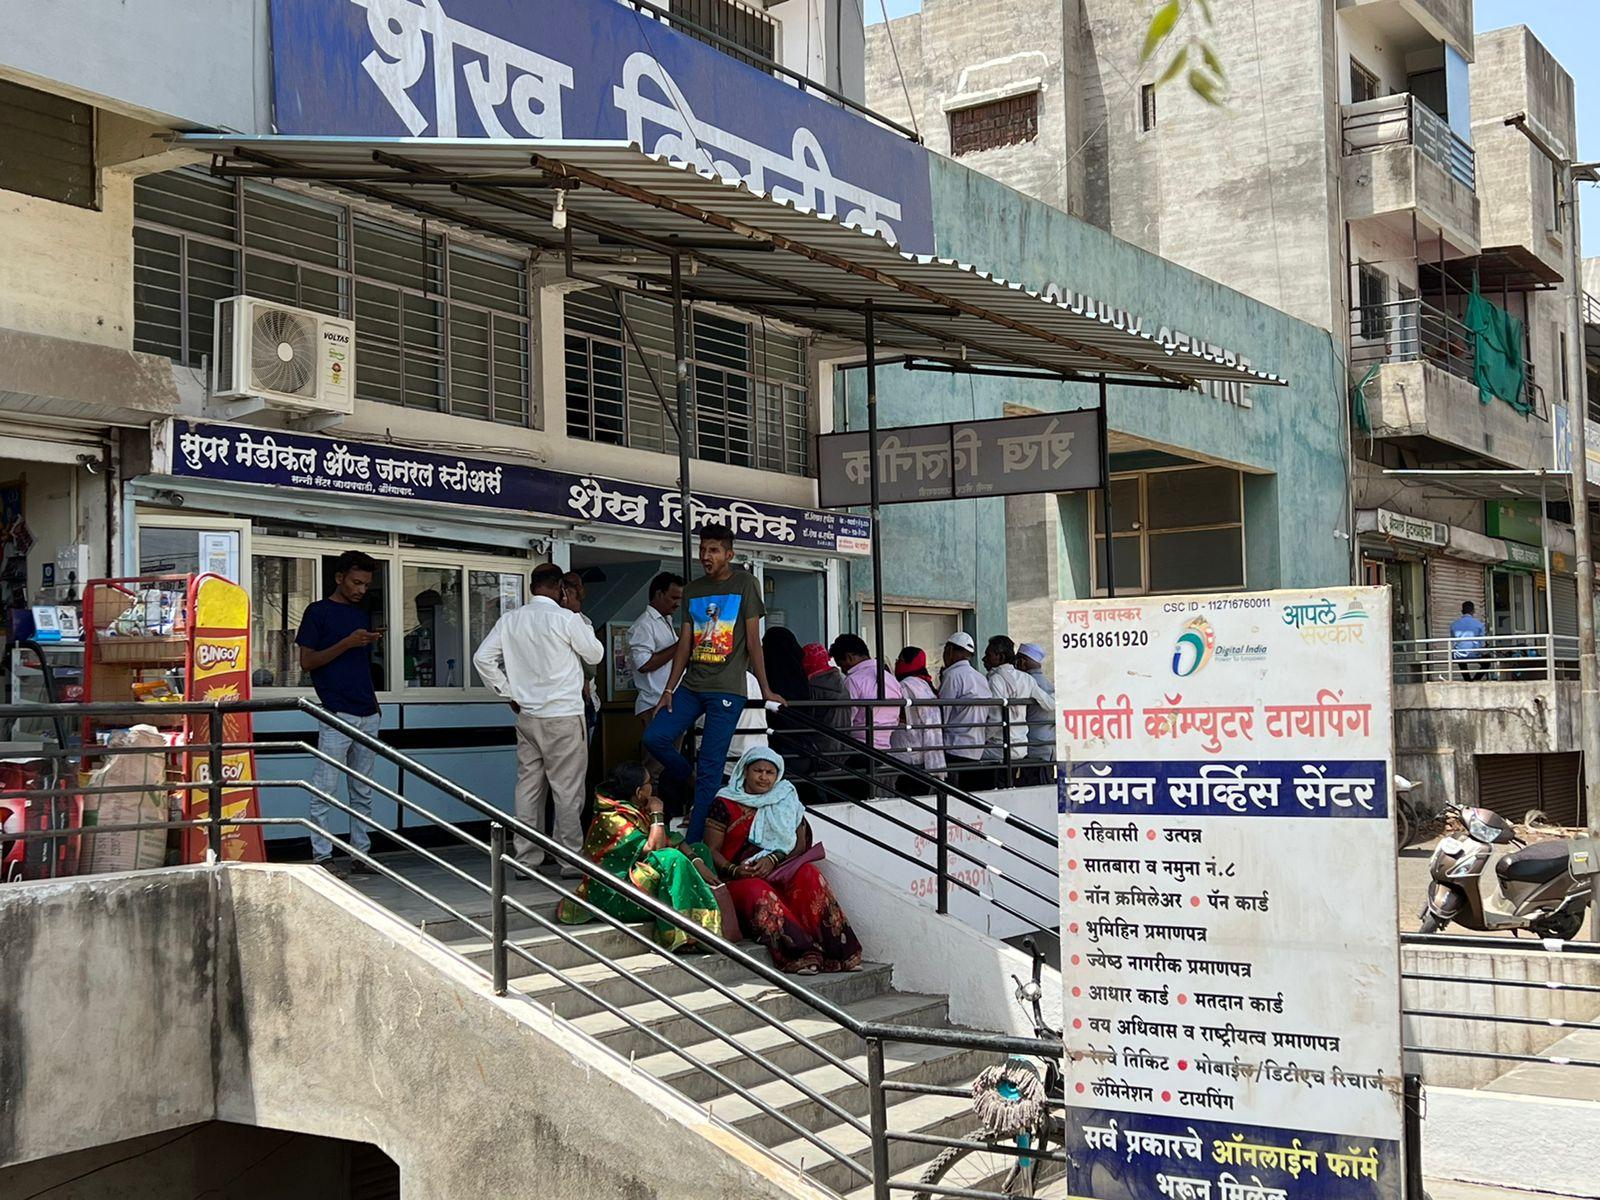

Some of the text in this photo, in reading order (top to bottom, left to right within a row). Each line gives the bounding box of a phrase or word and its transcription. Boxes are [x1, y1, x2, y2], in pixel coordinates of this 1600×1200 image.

[323, 332, 349, 344] VOLTAS
[180, 433, 230, 470] सुपर
[235, 433, 317, 474] मेडीकल
[375, 458, 434, 487] जनरल
[568, 479, 648, 525] शेख
[1164, 602, 1185, 612] CSC
[1188, 601, 1199, 611] ID
[1208, 598, 1271, 611] 112716760011
[1282, 598, 1336, 629] आपले
[1067, 608, 1143, 628] राजु बावस्कर
[1062, 630, 1149, 649] 9561861920
[1300, 623, 1364, 644] सरकार
[200, 645, 240, 668] BINGO!
[1215, 643, 1267, 657] Digital India
[1063, 688, 1372, 753] पार्वती कॉम्प्युटर टायपिंग
[199, 762, 244, 784] BGO!
[1065, 764, 1375, 812] कॉमन सर्व्हिस सेंटर
[1083, 821, 1202, 844] रहिवासी उत्पन्न
[1083, 858, 1140, 874] सातबारा
[1145, 860, 1157, 874] व
[1162, 861, 1200, 882] नमुना
[1085, 885, 1110, 905] नॉन
[1207, 889, 1229, 910] पॅन
[1234, 891, 1269, 912] कार्ड
[1086, 917, 1207, 942] भुमिहिन प्रमाणपत्र
[1086, 948, 1252, 978] ज्येष्ठ नागरीक प्रमाणपत्र
[1088, 984, 1284, 1014] आधार कार्ड मतदान कार्ड
[1088, 1015, 1340, 1052] वय अधिवास व राष्ट्रीयत्व प्रमाणपत्र
[1122, 1046, 1169, 1071] तिकिट
[1091, 1078, 1234, 1111] लॅमिनेशन टायपिंग
[1082, 1118, 1379, 1182] सर्व प्रकारचे ऑनलाईन फॉर्म
